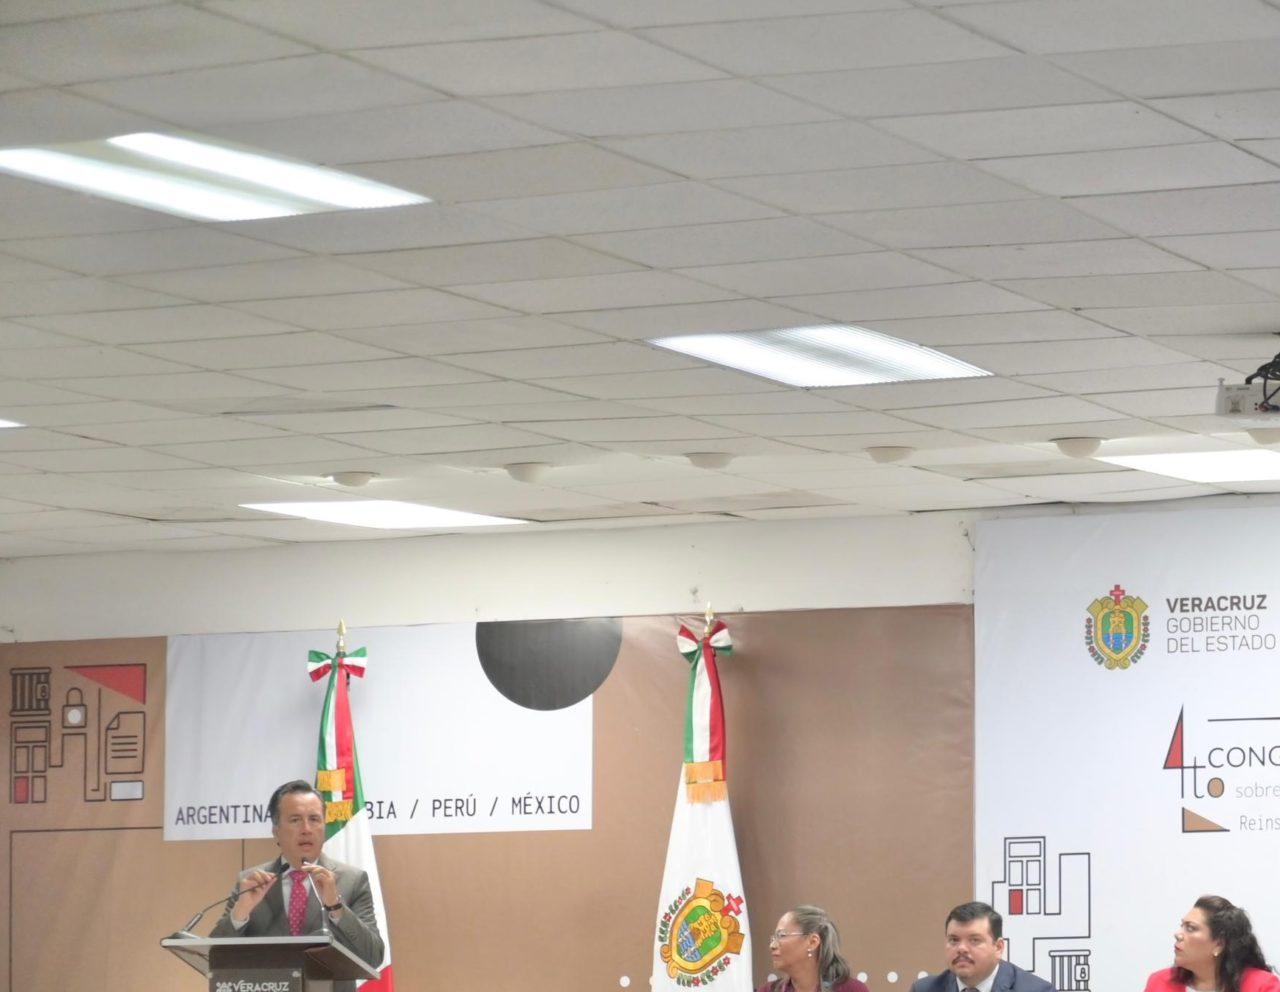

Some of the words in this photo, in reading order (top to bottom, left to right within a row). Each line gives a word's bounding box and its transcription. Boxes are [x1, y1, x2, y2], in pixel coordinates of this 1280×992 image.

[1166, 594, 1268, 613] VERACRUZ
[1166, 614, 1260, 634] GOBIERNO
[1167, 637, 1200, 653] DEL
[1206, 633, 1276, 652] ESTADO
[432, 793, 477, 818] PERÚ
[511, 791, 581, 815] MÉXICO
[175, 804, 273, 826] ARGENTINA
